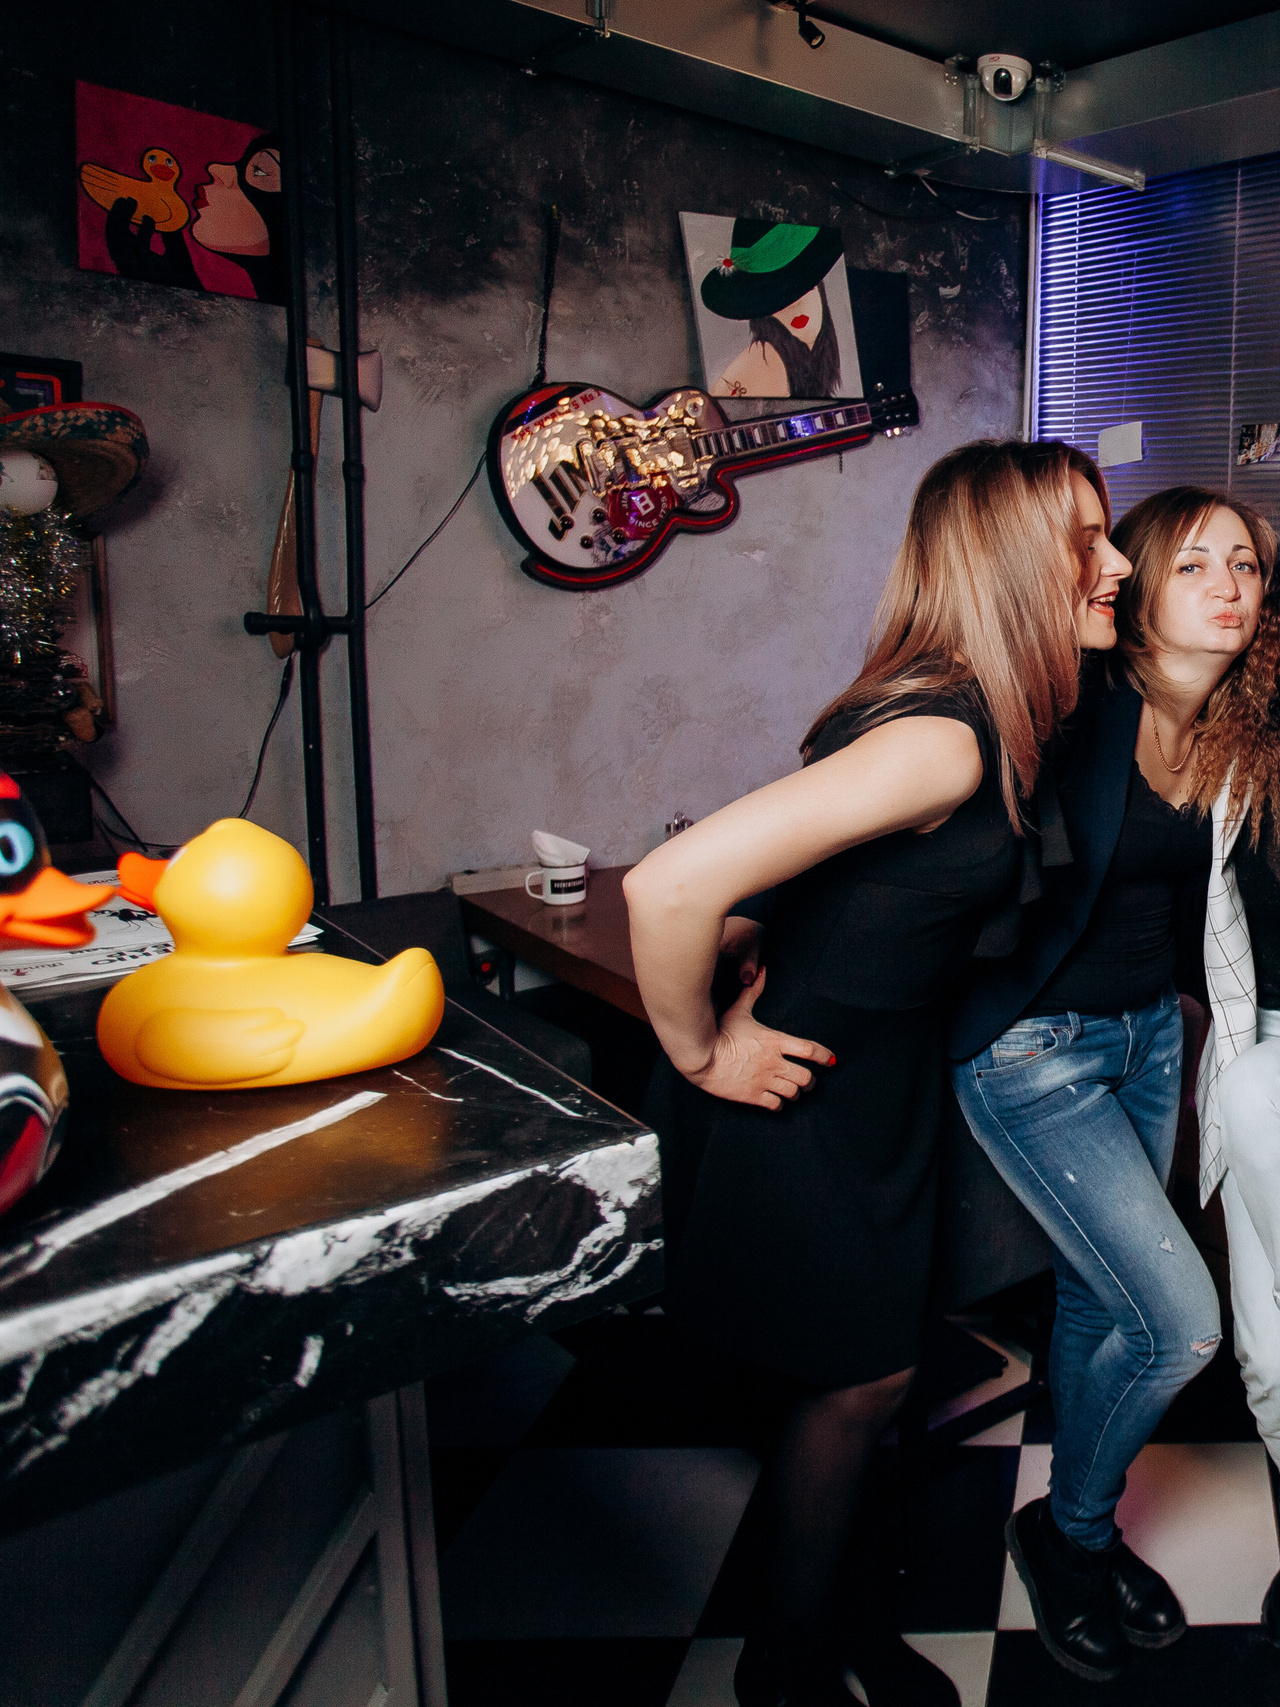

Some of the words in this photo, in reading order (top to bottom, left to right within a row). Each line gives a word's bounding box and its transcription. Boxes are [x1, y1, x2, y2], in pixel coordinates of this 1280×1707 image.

[659, 495, 668, 519] 1795
[629, 517, 659, 528] SINCE
[91, 947, 173, 965] ЕНЮ
